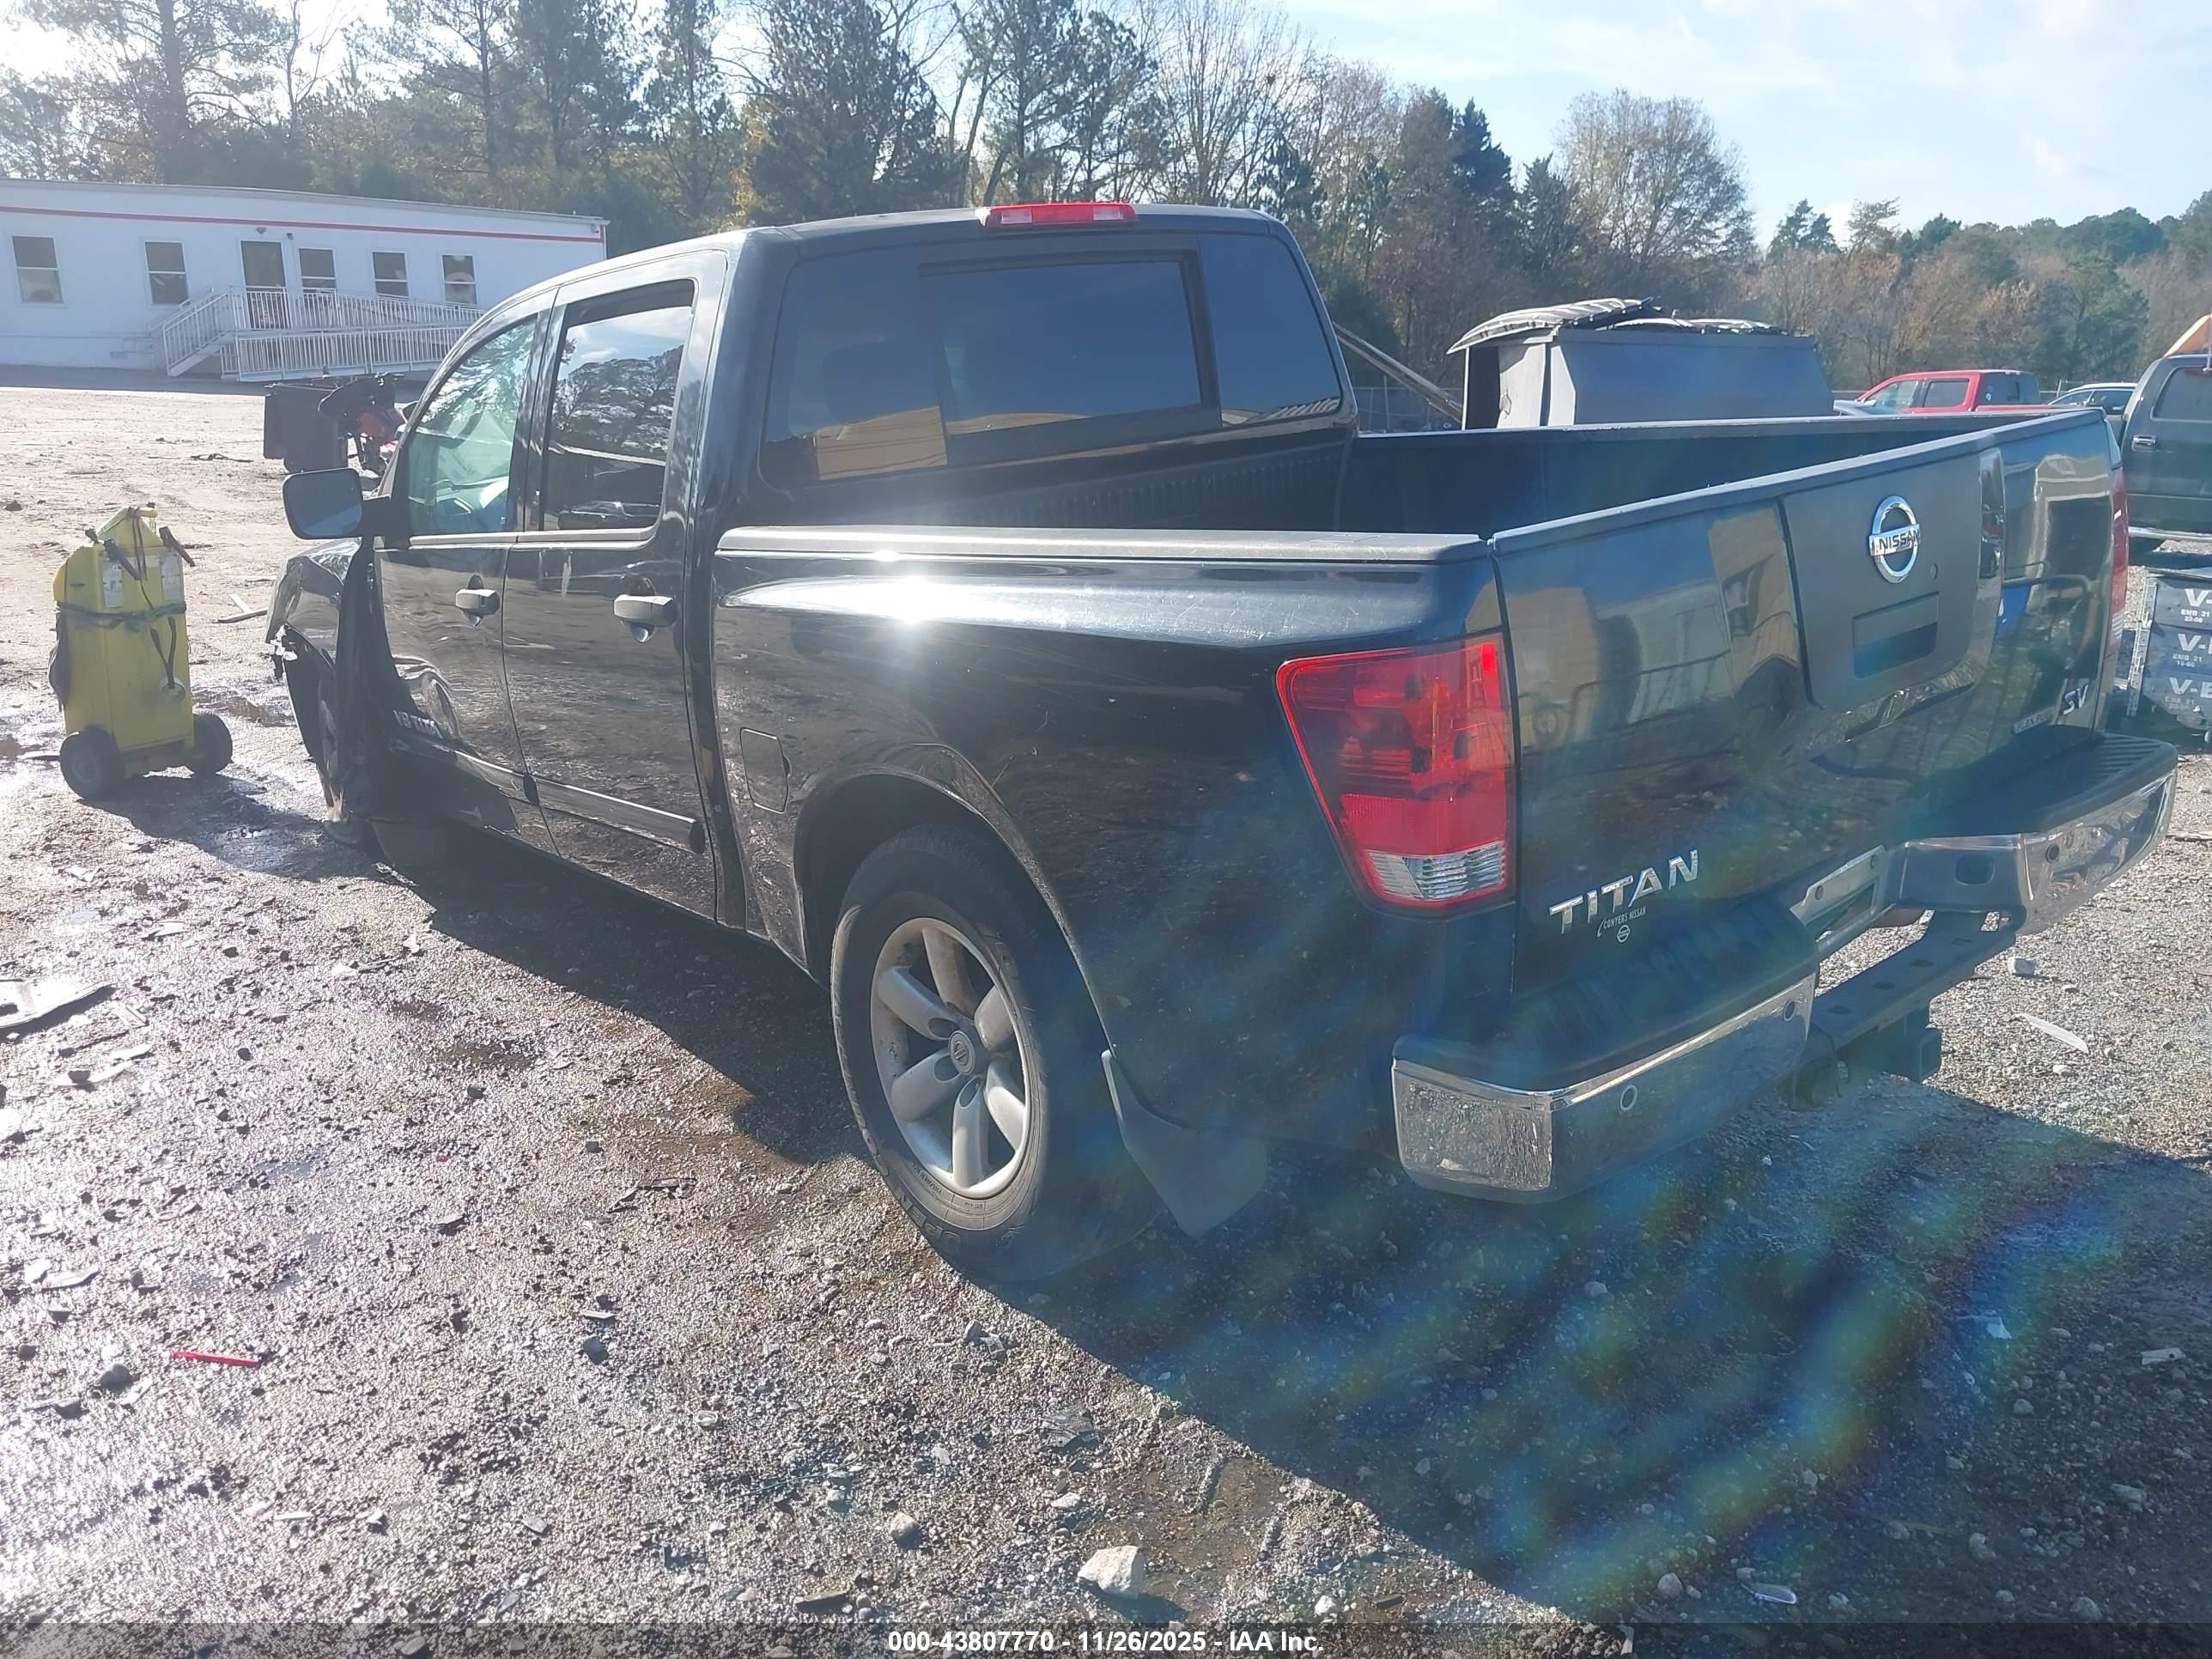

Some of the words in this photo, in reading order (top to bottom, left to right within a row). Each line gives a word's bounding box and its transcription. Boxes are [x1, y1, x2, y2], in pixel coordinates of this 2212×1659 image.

[1878, 528, 1921, 550] NISSAN
[2063, 684, 2089, 715] SV
[1549, 848, 1698, 935] TITAN
